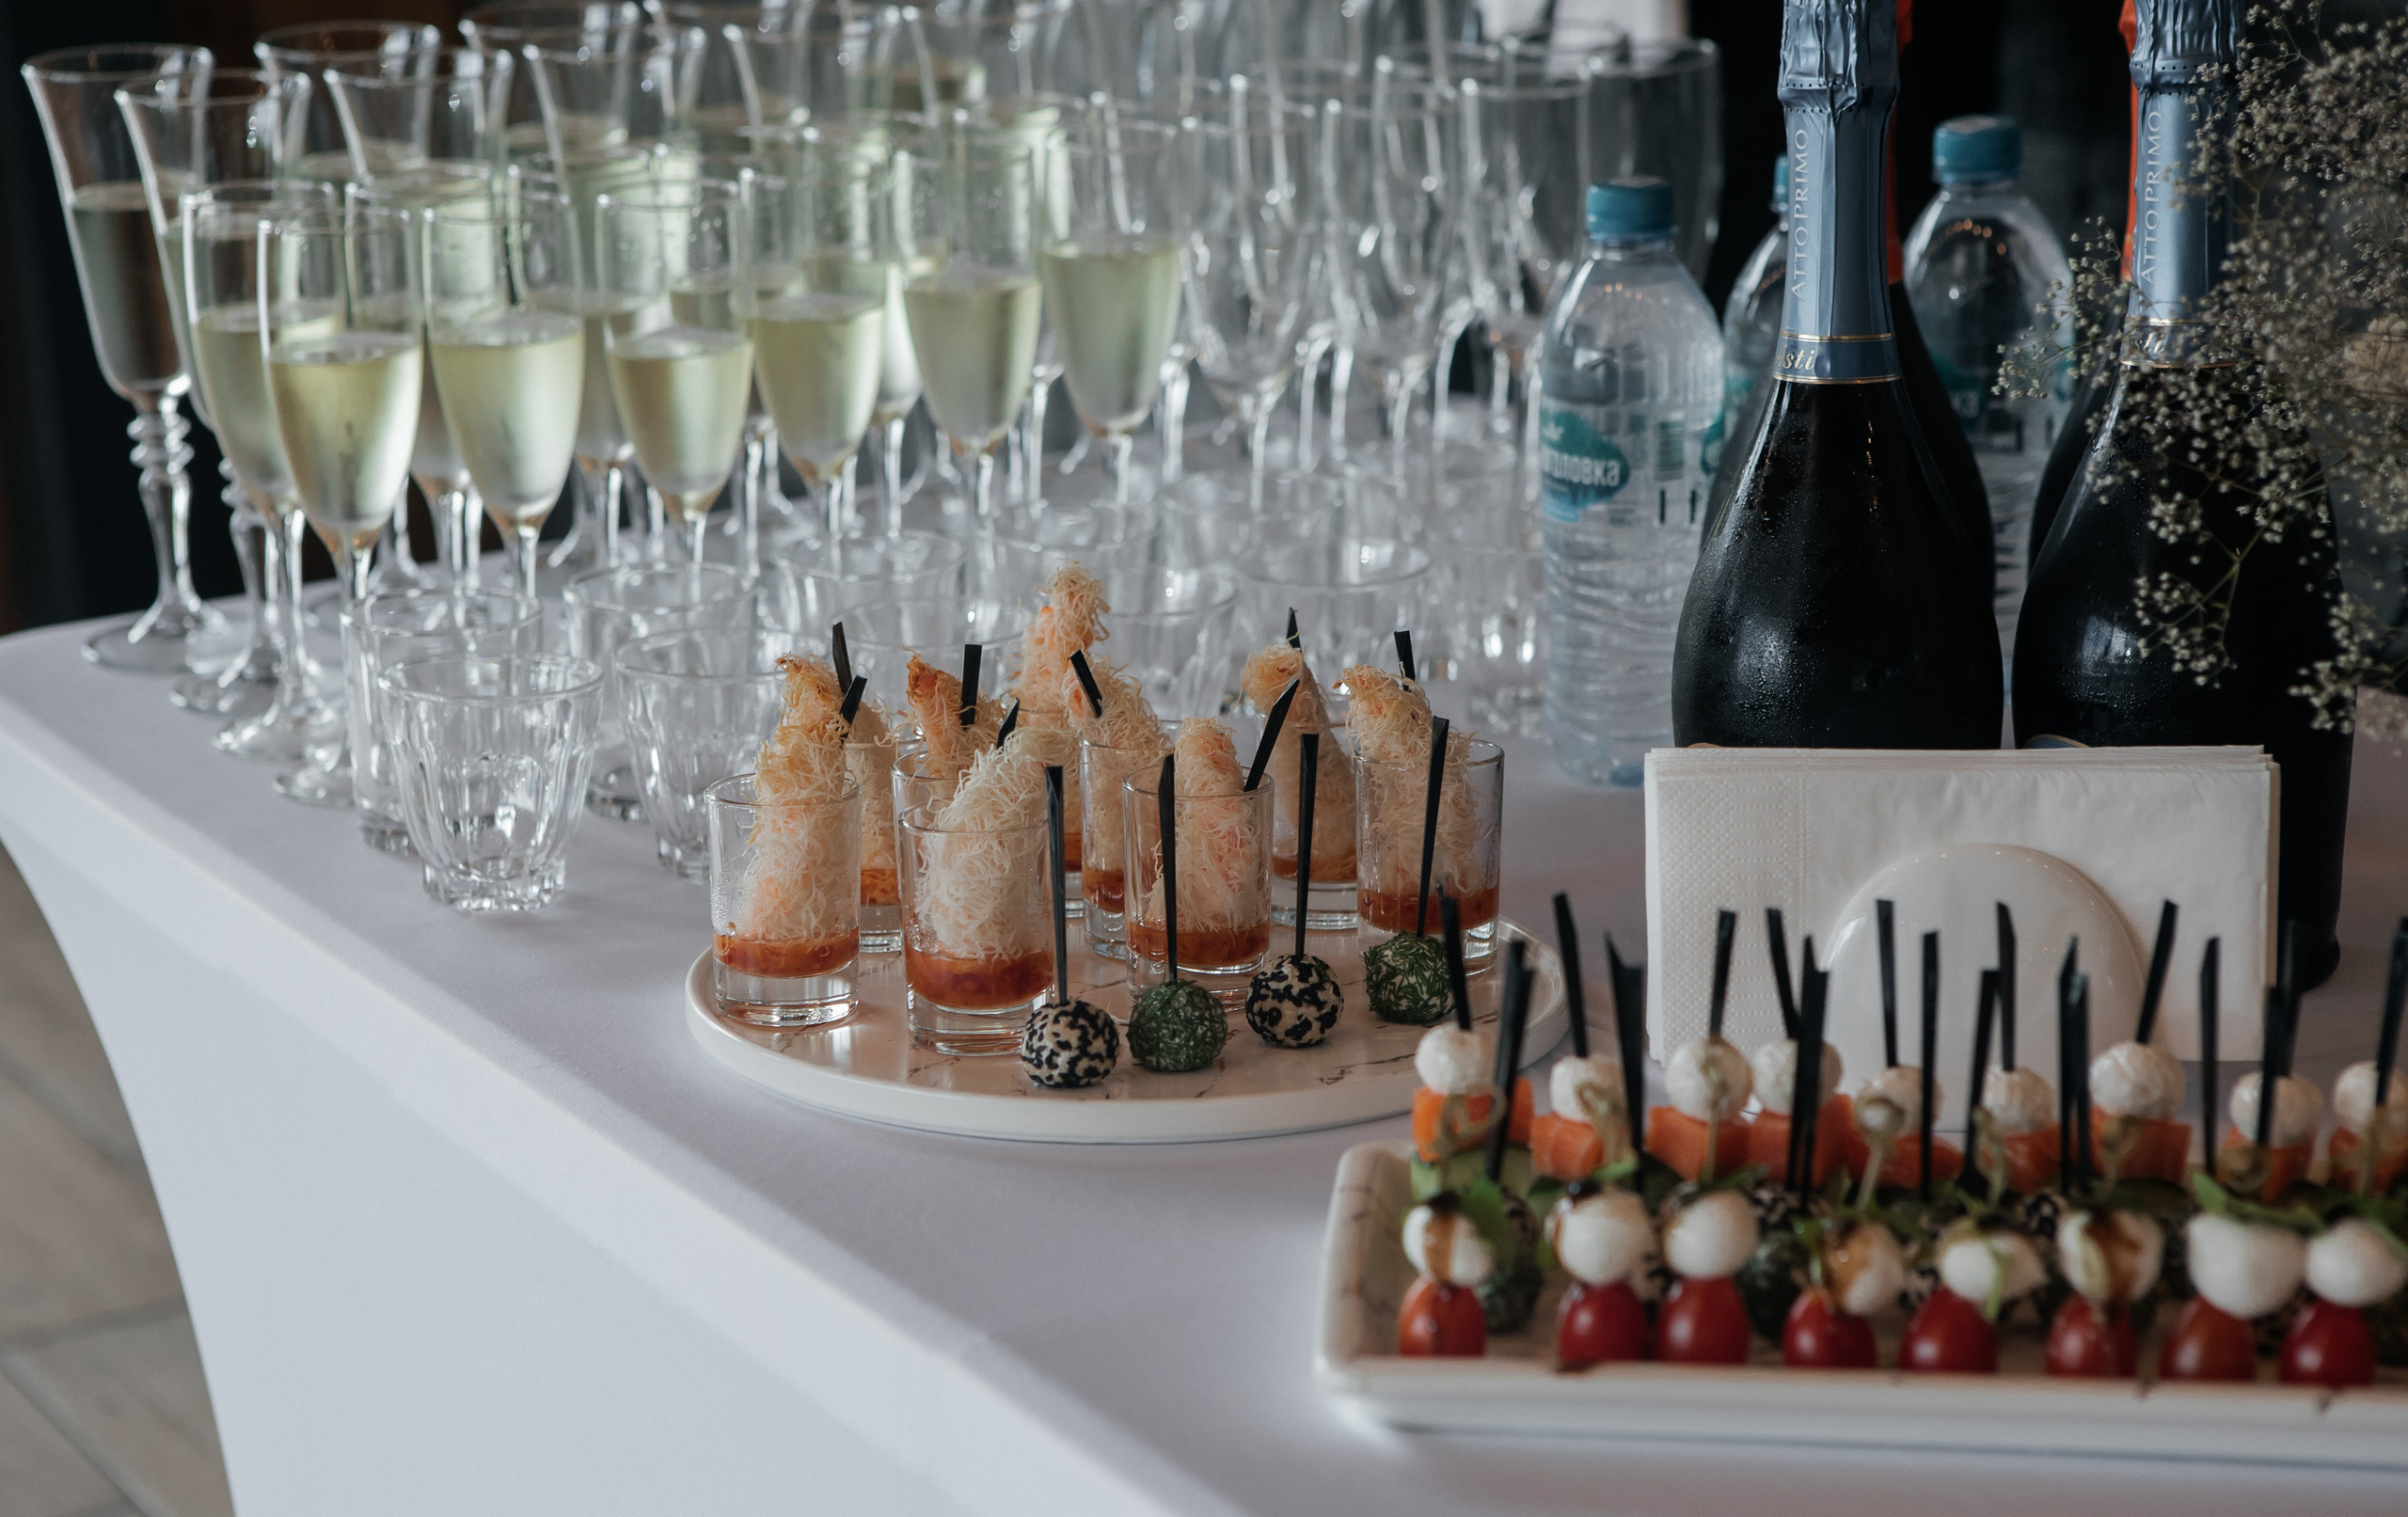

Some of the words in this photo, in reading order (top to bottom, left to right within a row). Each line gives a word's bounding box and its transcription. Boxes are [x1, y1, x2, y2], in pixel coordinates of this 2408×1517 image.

[1794, 128, 1810, 220] PRIMO
[2145, 110, 2163, 203] PRIMO
[1791, 226, 1810, 302] ATTO
[2140, 209, 2160, 286] ATTO
[1775, 344, 1816, 371] Asti
